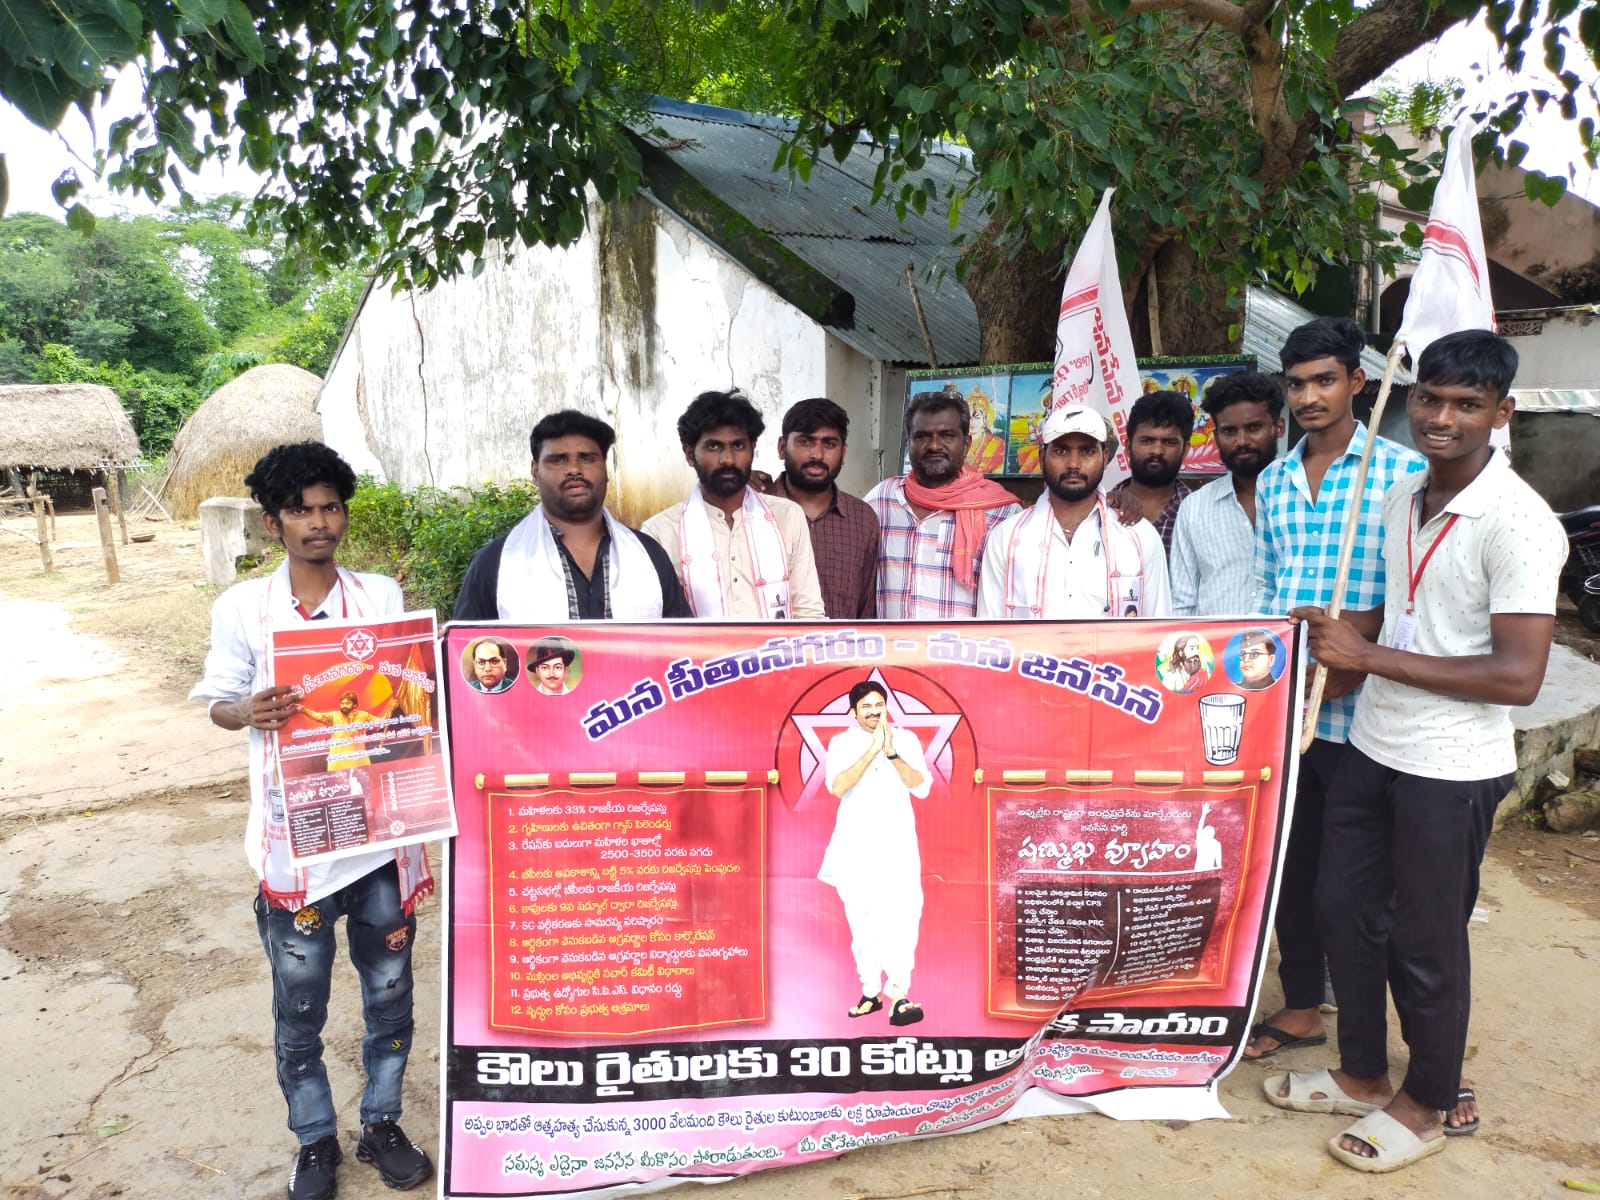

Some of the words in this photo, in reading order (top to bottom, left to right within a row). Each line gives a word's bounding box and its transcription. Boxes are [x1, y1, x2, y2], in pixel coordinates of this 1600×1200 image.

[1092, 306, 1124, 405] జనసేన
[379, 661, 401, 676] మన
[402, 668, 435, 692] జనసేన
[582, 679, 664, 739] మన
[666, 631, 884, 699] సీతానగరం
[928, 633, 1013, 669] మన
[1020, 652, 1162, 723] జనసేన
[518, 806, 562, 816] మహిళలకు
[565, 805, 585, 814] 33%
[589, 801, 625, 813] రాజకీయ
[508, 824, 518, 834] 2.
[572, 821, 610, 831] ఉచితంగా
[613, 820, 632, 834] గ్యాస్
[1080, 823, 1109, 833] జనసేన
[508, 841, 518, 850] 3.
[554, 838, 591, 848] బదులుగా
[594, 837, 628, 847] మహిళల
[600, 849, 661, 859] 2500-3500
[664, 847, 687, 857] వరకు
[689, 847, 713, 857] నగదు
[1018, 835, 1095, 870] షణ్ముఖ
[1104, 838, 1192, 870] వ్యూహం
[508, 870, 518, 879] 4.
[619, 866, 633, 875] 5%
[636, 865, 659, 874] వరకు
[508, 888, 518, 897] 5.
[597, 880, 633, 892] రాజకీయ
[508, 905, 518, 913] 6.
[610, 900, 634, 912] ద్వారా
[509, 922, 518, 930] 7.
[522, 921, 534, 930] SC
[1087, 919, 1104, 927] PRC
[509, 938, 518, 947] 8.
[561, 933, 606, 946] వెనుకబడిన
[649, 930, 671, 942] కోసం
[509, 955, 519, 964] 9.
[561, 951, 606, 963] వెనుకబడిన
[510, 972, 522, 980] 10.
[631, 984, 662, 995] విధానం
[665, 982, 682, 998] రద్దు
[555, 1003, 577, 1016] కోసం
[477, 1051, 584, 1086] కౌలు
[596, 1046, 778, 1097] రైతులకు
[790, 1047, 850, 1077] 30
[861, 1037, 973, 1084] కోట్లు
[1086, 1012, 1228, 1036] సాయం
[464, 1115, 494, 1136] అప్పల
[496, 1114, 531, 1134] భాదతో
[534, 1116, 581, 1138] ఆత్మహత్య
[583, 1114, 632, 1136] చేసుకున్న
[633, 1117, 666, 1131] 3000
[669, 1111, 715, 1128] వేలమంది
[718, 1111, 742, 1126] కౌలు
[745, 1110, 775, 1130] రైతుల
[777, 1104, 842, 1123] కుటుంబాలకు
[848, 1108, 864, 1124] లక్ష
[866, 1103, 923, 1120] రూపాయలు
[504, 1154, 544, 1178] సమస్య
[800, 1136, 815, 1152] మీ
